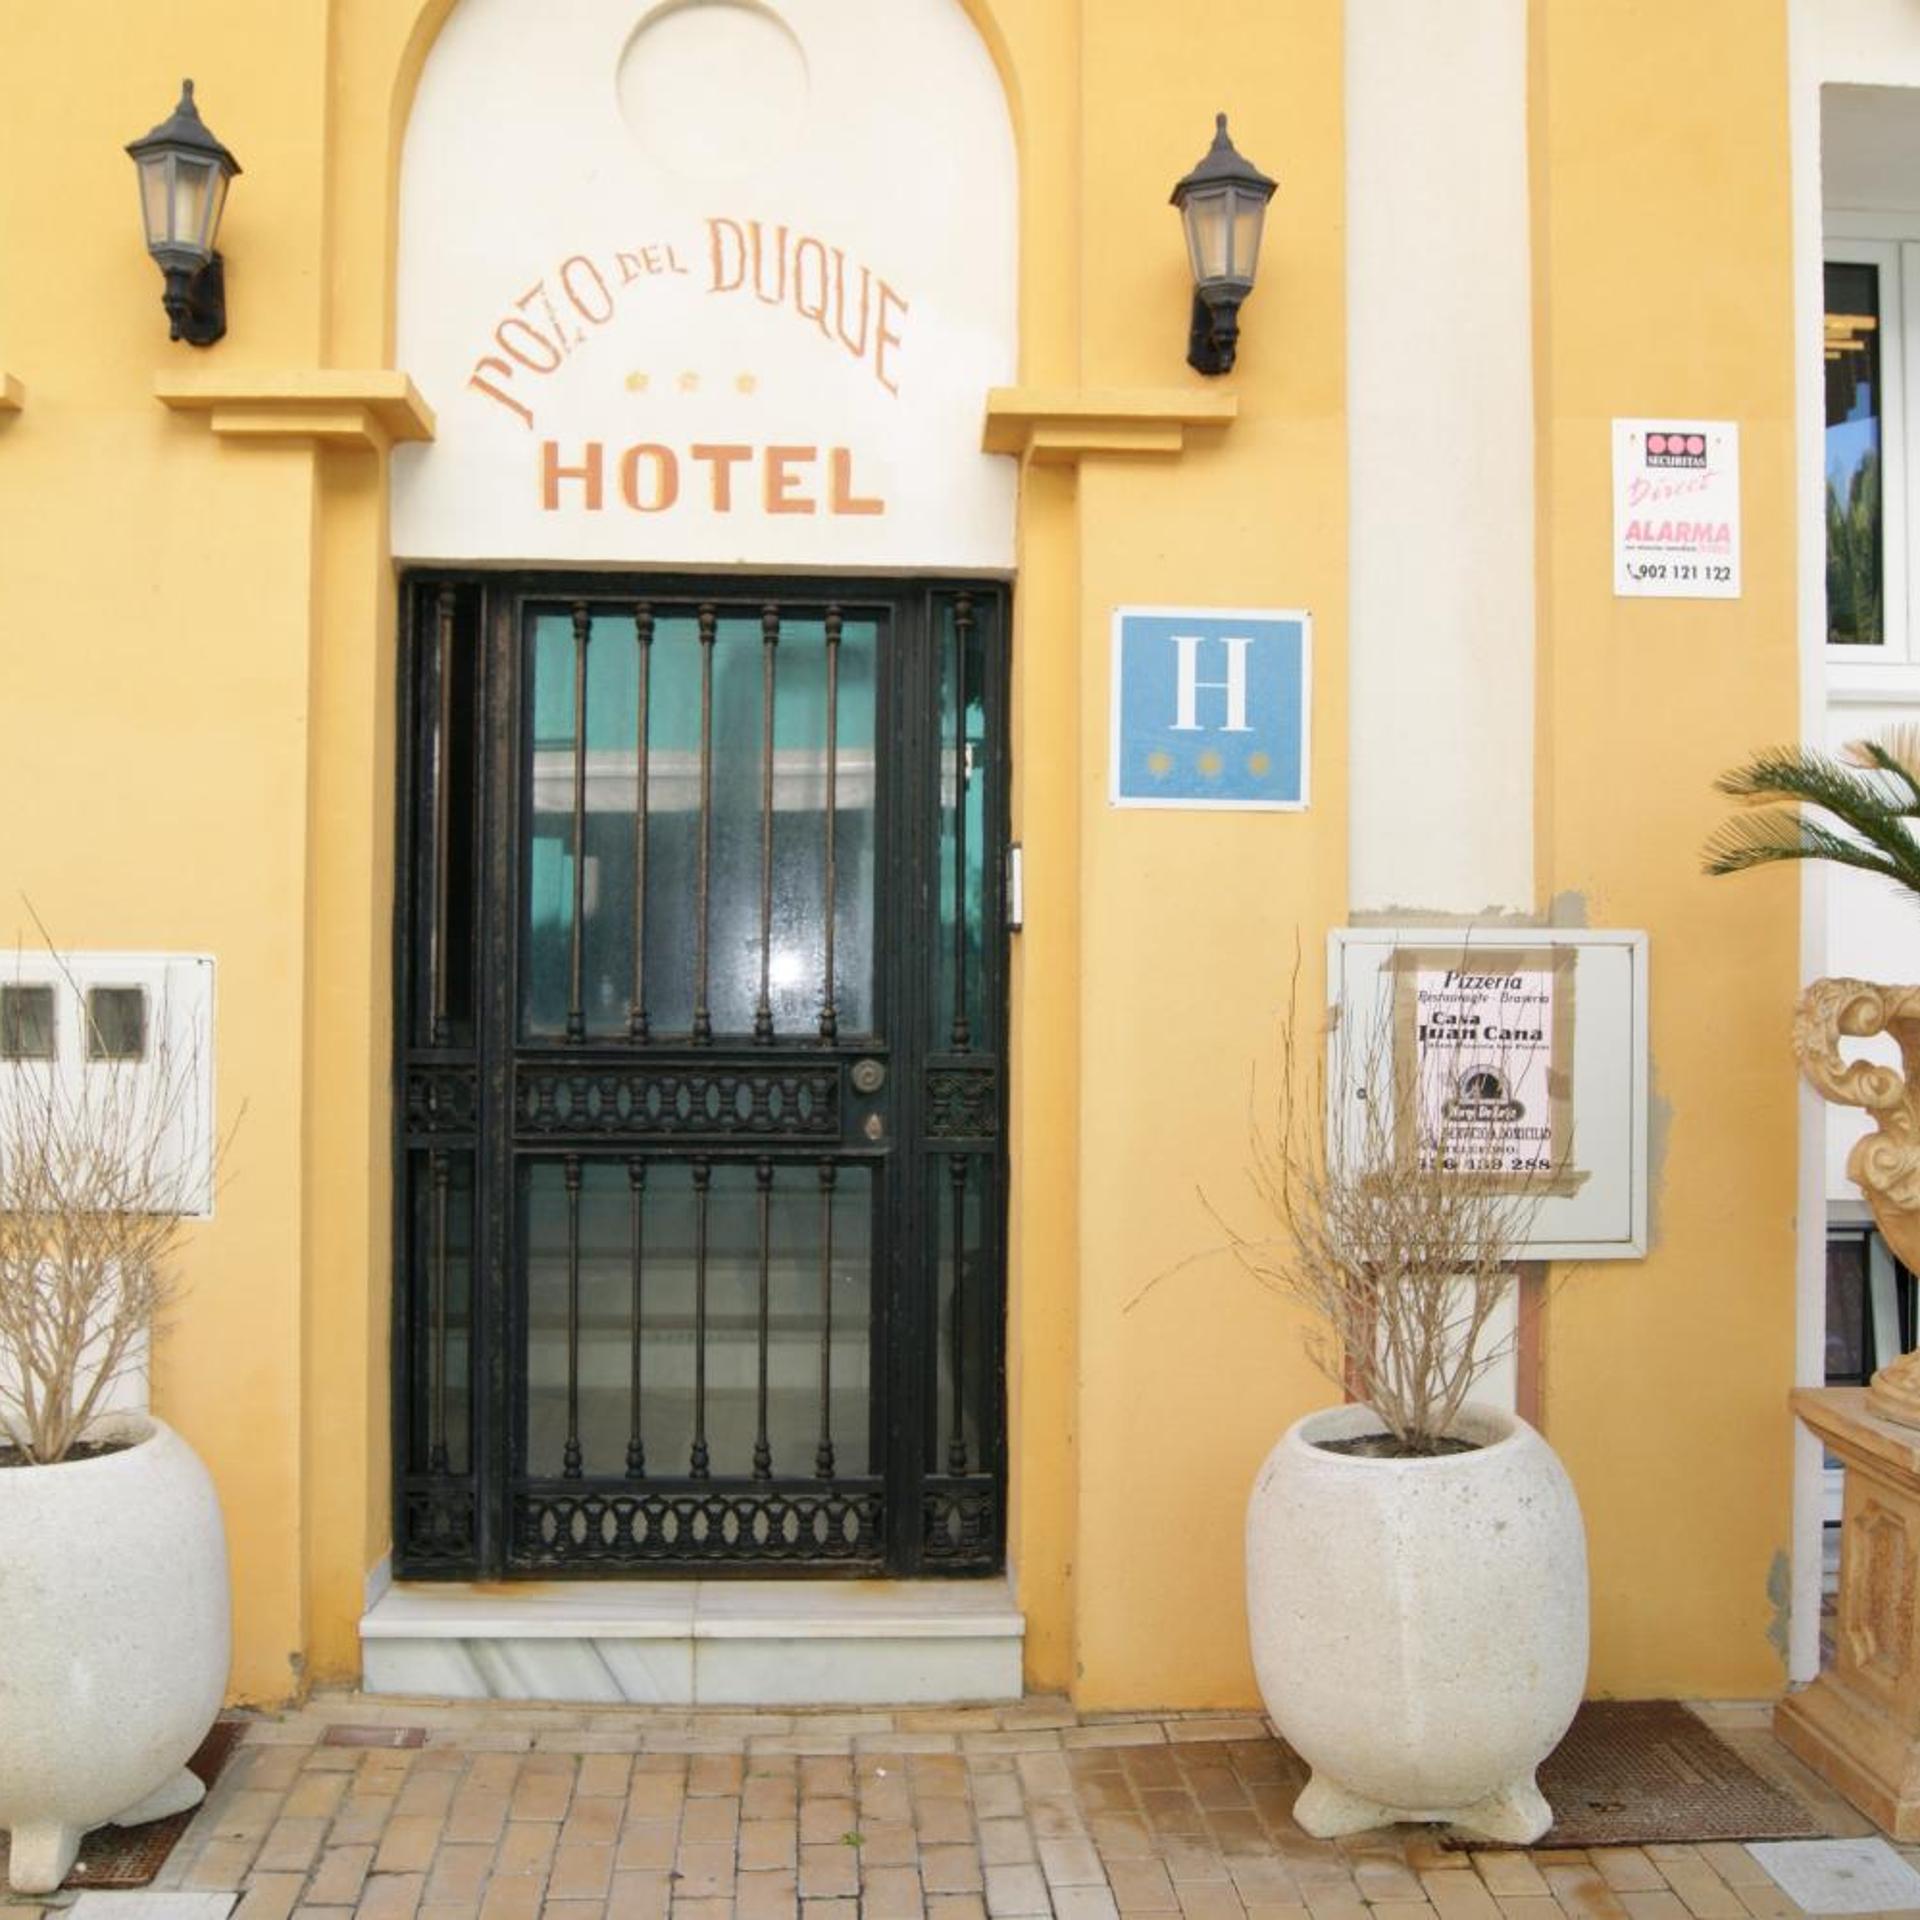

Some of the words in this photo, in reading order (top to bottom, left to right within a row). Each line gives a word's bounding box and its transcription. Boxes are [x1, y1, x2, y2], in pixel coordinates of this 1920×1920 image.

[466, 254, 614, 430] POZO
[616, 244, 689, 285] DEL
[706, 217, 909, 399] DUQUE
[541, 441, 885, 515] HOTEL
[1625, 519, 1731, 542] ALARMA
[1639, 564, 1667, 579] 902
[1673, 564, 1697, 579] 121
[1705, 565, 1731, 581] 122
[1168, 635, 1255, 732] H
[1432, 1011, 1481, 1025] Casa
[1419, 1025, 1477, 1042] Juan
[1511, 1158, 1551, 1170] 288
